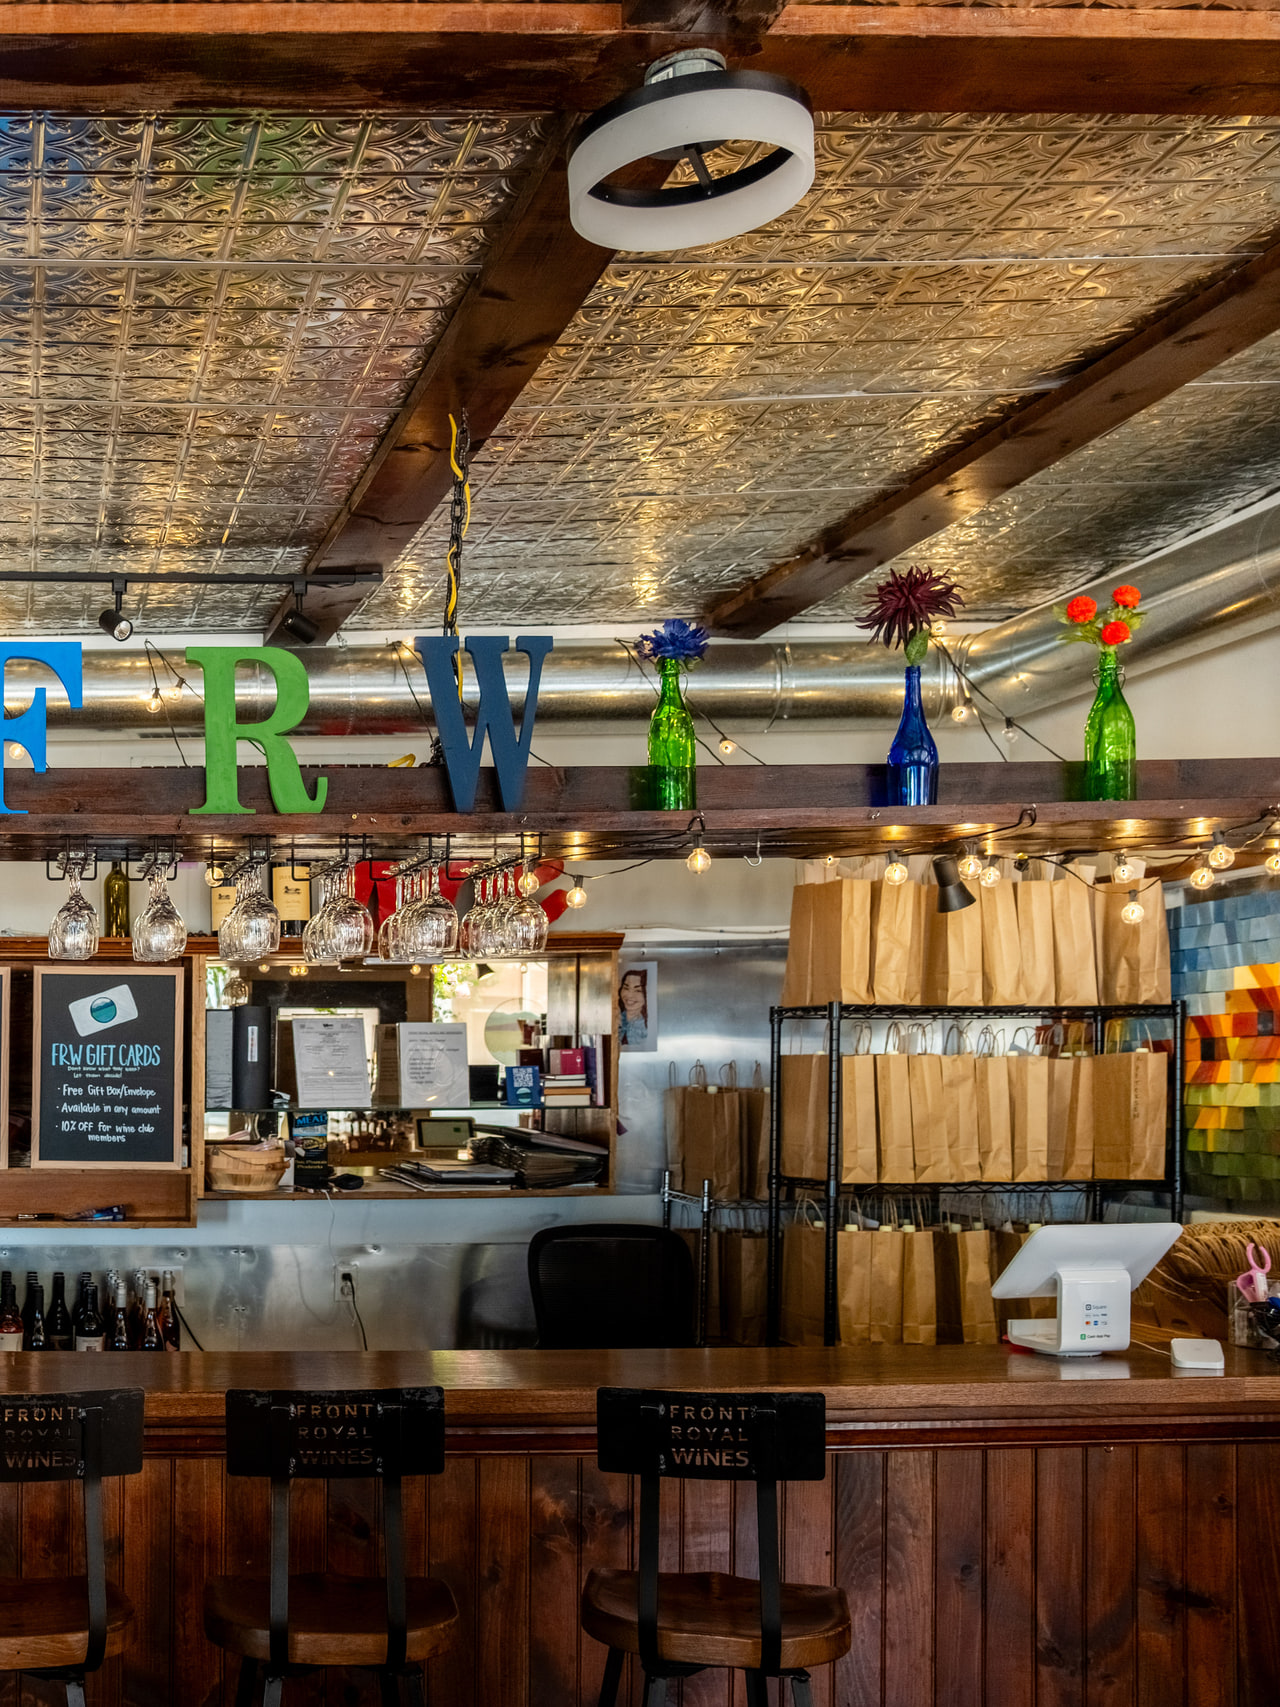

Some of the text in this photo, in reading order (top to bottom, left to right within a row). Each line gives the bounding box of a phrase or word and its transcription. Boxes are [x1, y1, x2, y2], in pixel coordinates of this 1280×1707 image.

[51, 1043, 161, 1067] FRW GIFT CARDS
[62, 1084, 156, 1099] Free Gift Box/Envelope
[61, 1102, 162, 1116] Available in any amount
[61, 1120, 77, 1132] 10%
[98, 1121, 112, 1132] for
[115, 1123, 135, 1133] wine
[138, 1123, 155, 1133] club
[88, 1134, 126, 1142] members
[4, 1406, 78, 1422] FRONT
[297, 1404, 374, 1419] FRONT
[670, 1405, 750, 1421] FRONT
[671, 1425, 749, 1442] ROYAL
[5, 1450, 77, 1468] WINES
[672, 1448, 750, 1467] WINES
